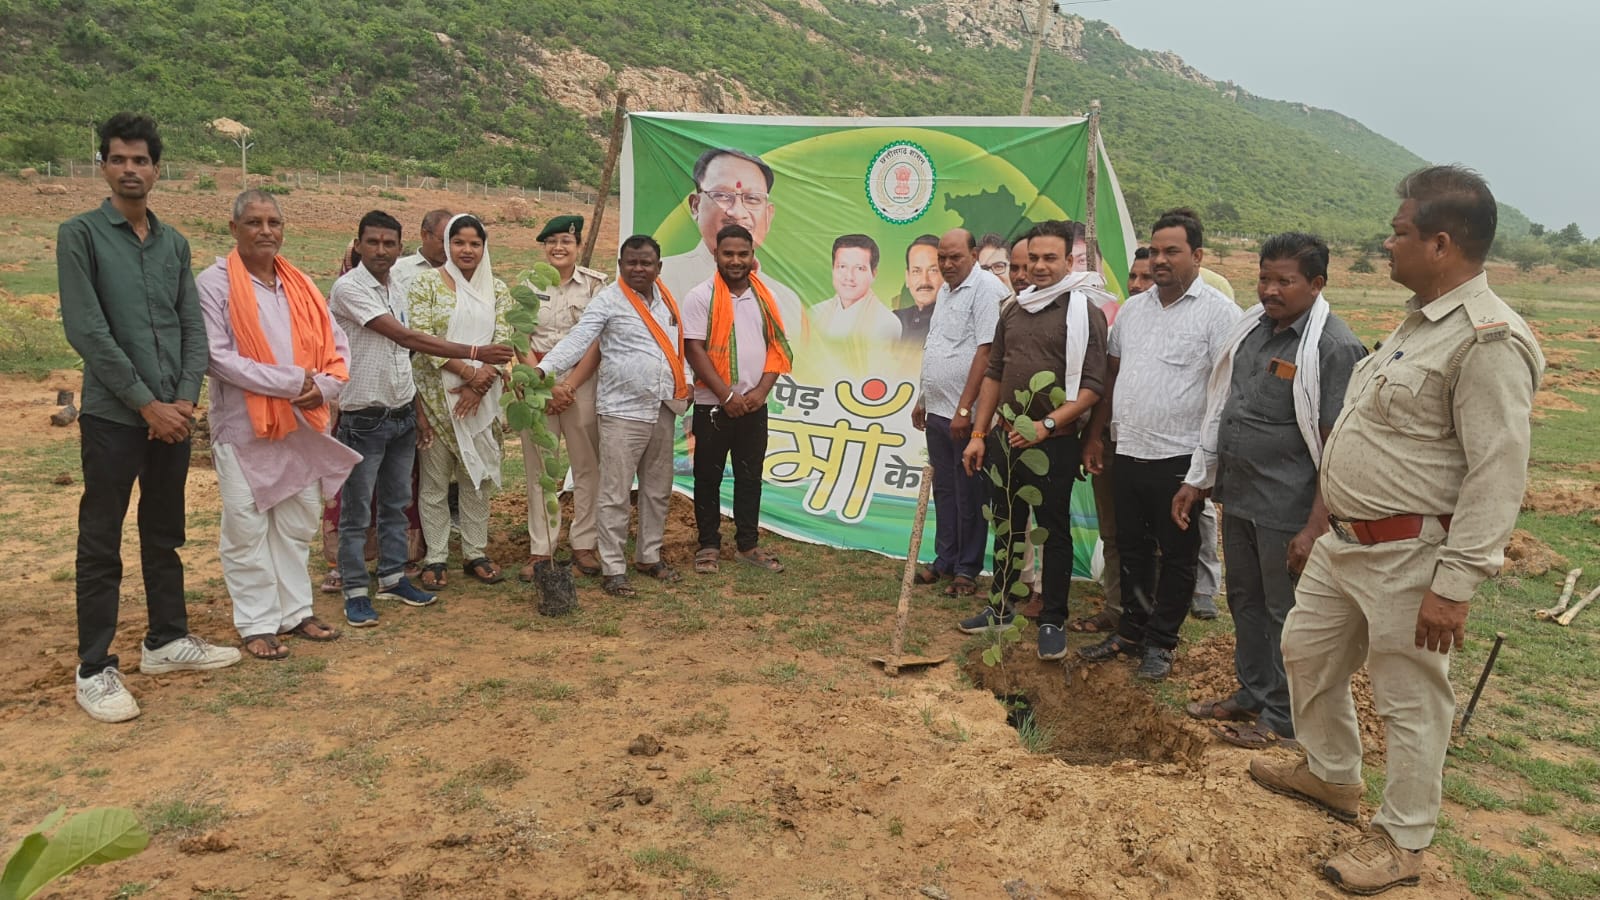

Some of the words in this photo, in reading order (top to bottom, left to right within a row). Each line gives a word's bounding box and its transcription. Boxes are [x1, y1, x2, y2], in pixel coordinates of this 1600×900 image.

[775, 374, 824, 416] पेड़
[763, 378, 915, 519] माँ
[884, 454, 923, 489] के
